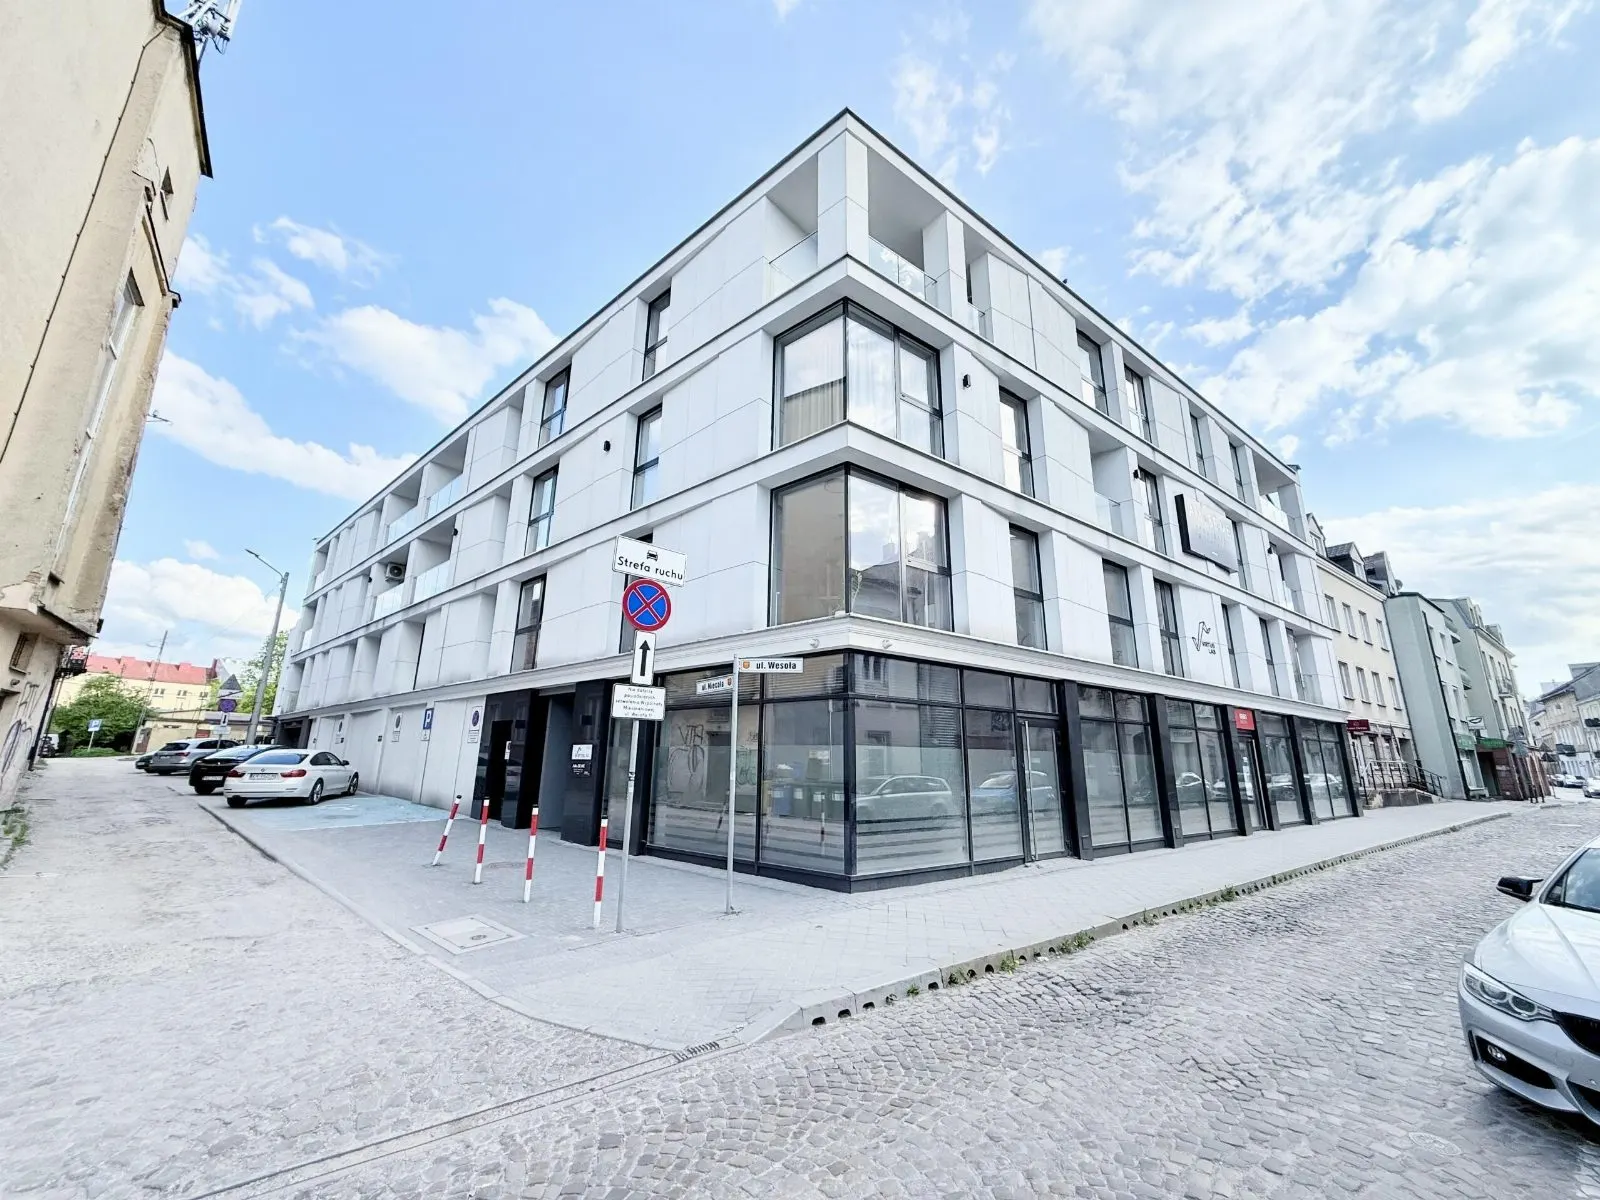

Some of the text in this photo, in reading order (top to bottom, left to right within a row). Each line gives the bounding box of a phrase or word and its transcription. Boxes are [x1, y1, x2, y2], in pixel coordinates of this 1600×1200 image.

[617, 556, 683, 580] Strefa ruchu
[756, 661, 766, 669] ul.
[424, 709, 433, 728] P
